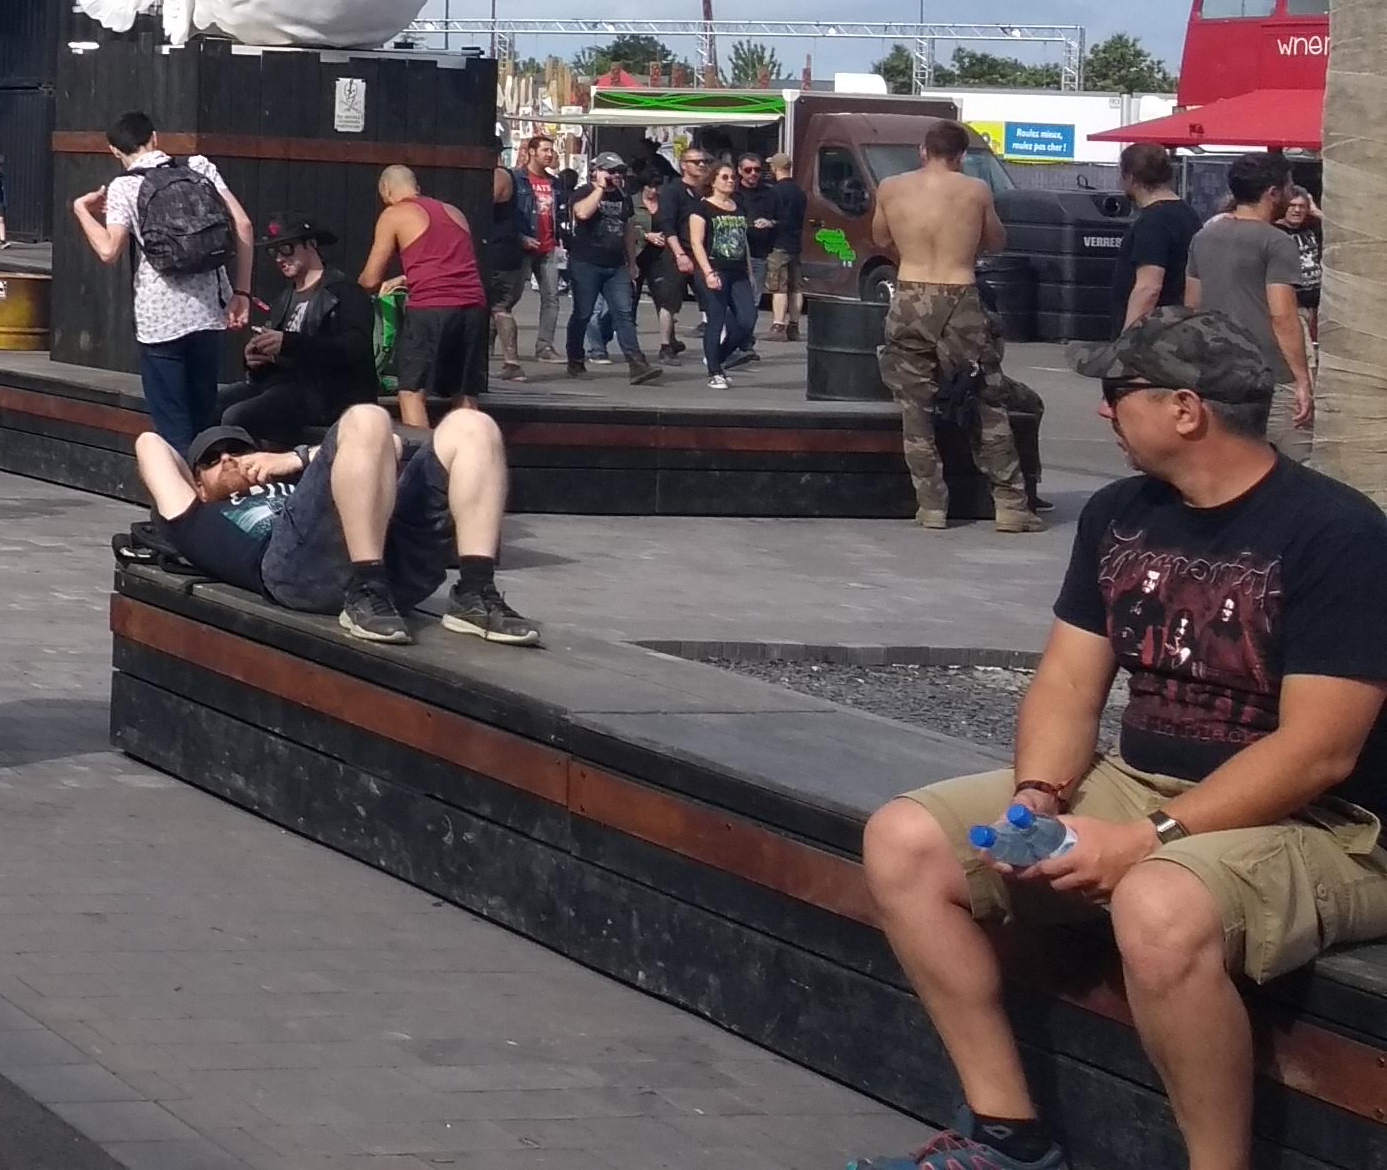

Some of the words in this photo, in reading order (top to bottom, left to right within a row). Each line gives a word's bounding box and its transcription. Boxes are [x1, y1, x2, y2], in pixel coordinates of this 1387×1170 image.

[1016, 128, 1039, 139] Roulez
[1040, 131, 1063, 140] mieux,
[1012, 142, 1032, 151] roulez
[1033, 143, 1046, 153] pas
[1047, 142, 1062, 152] cher
